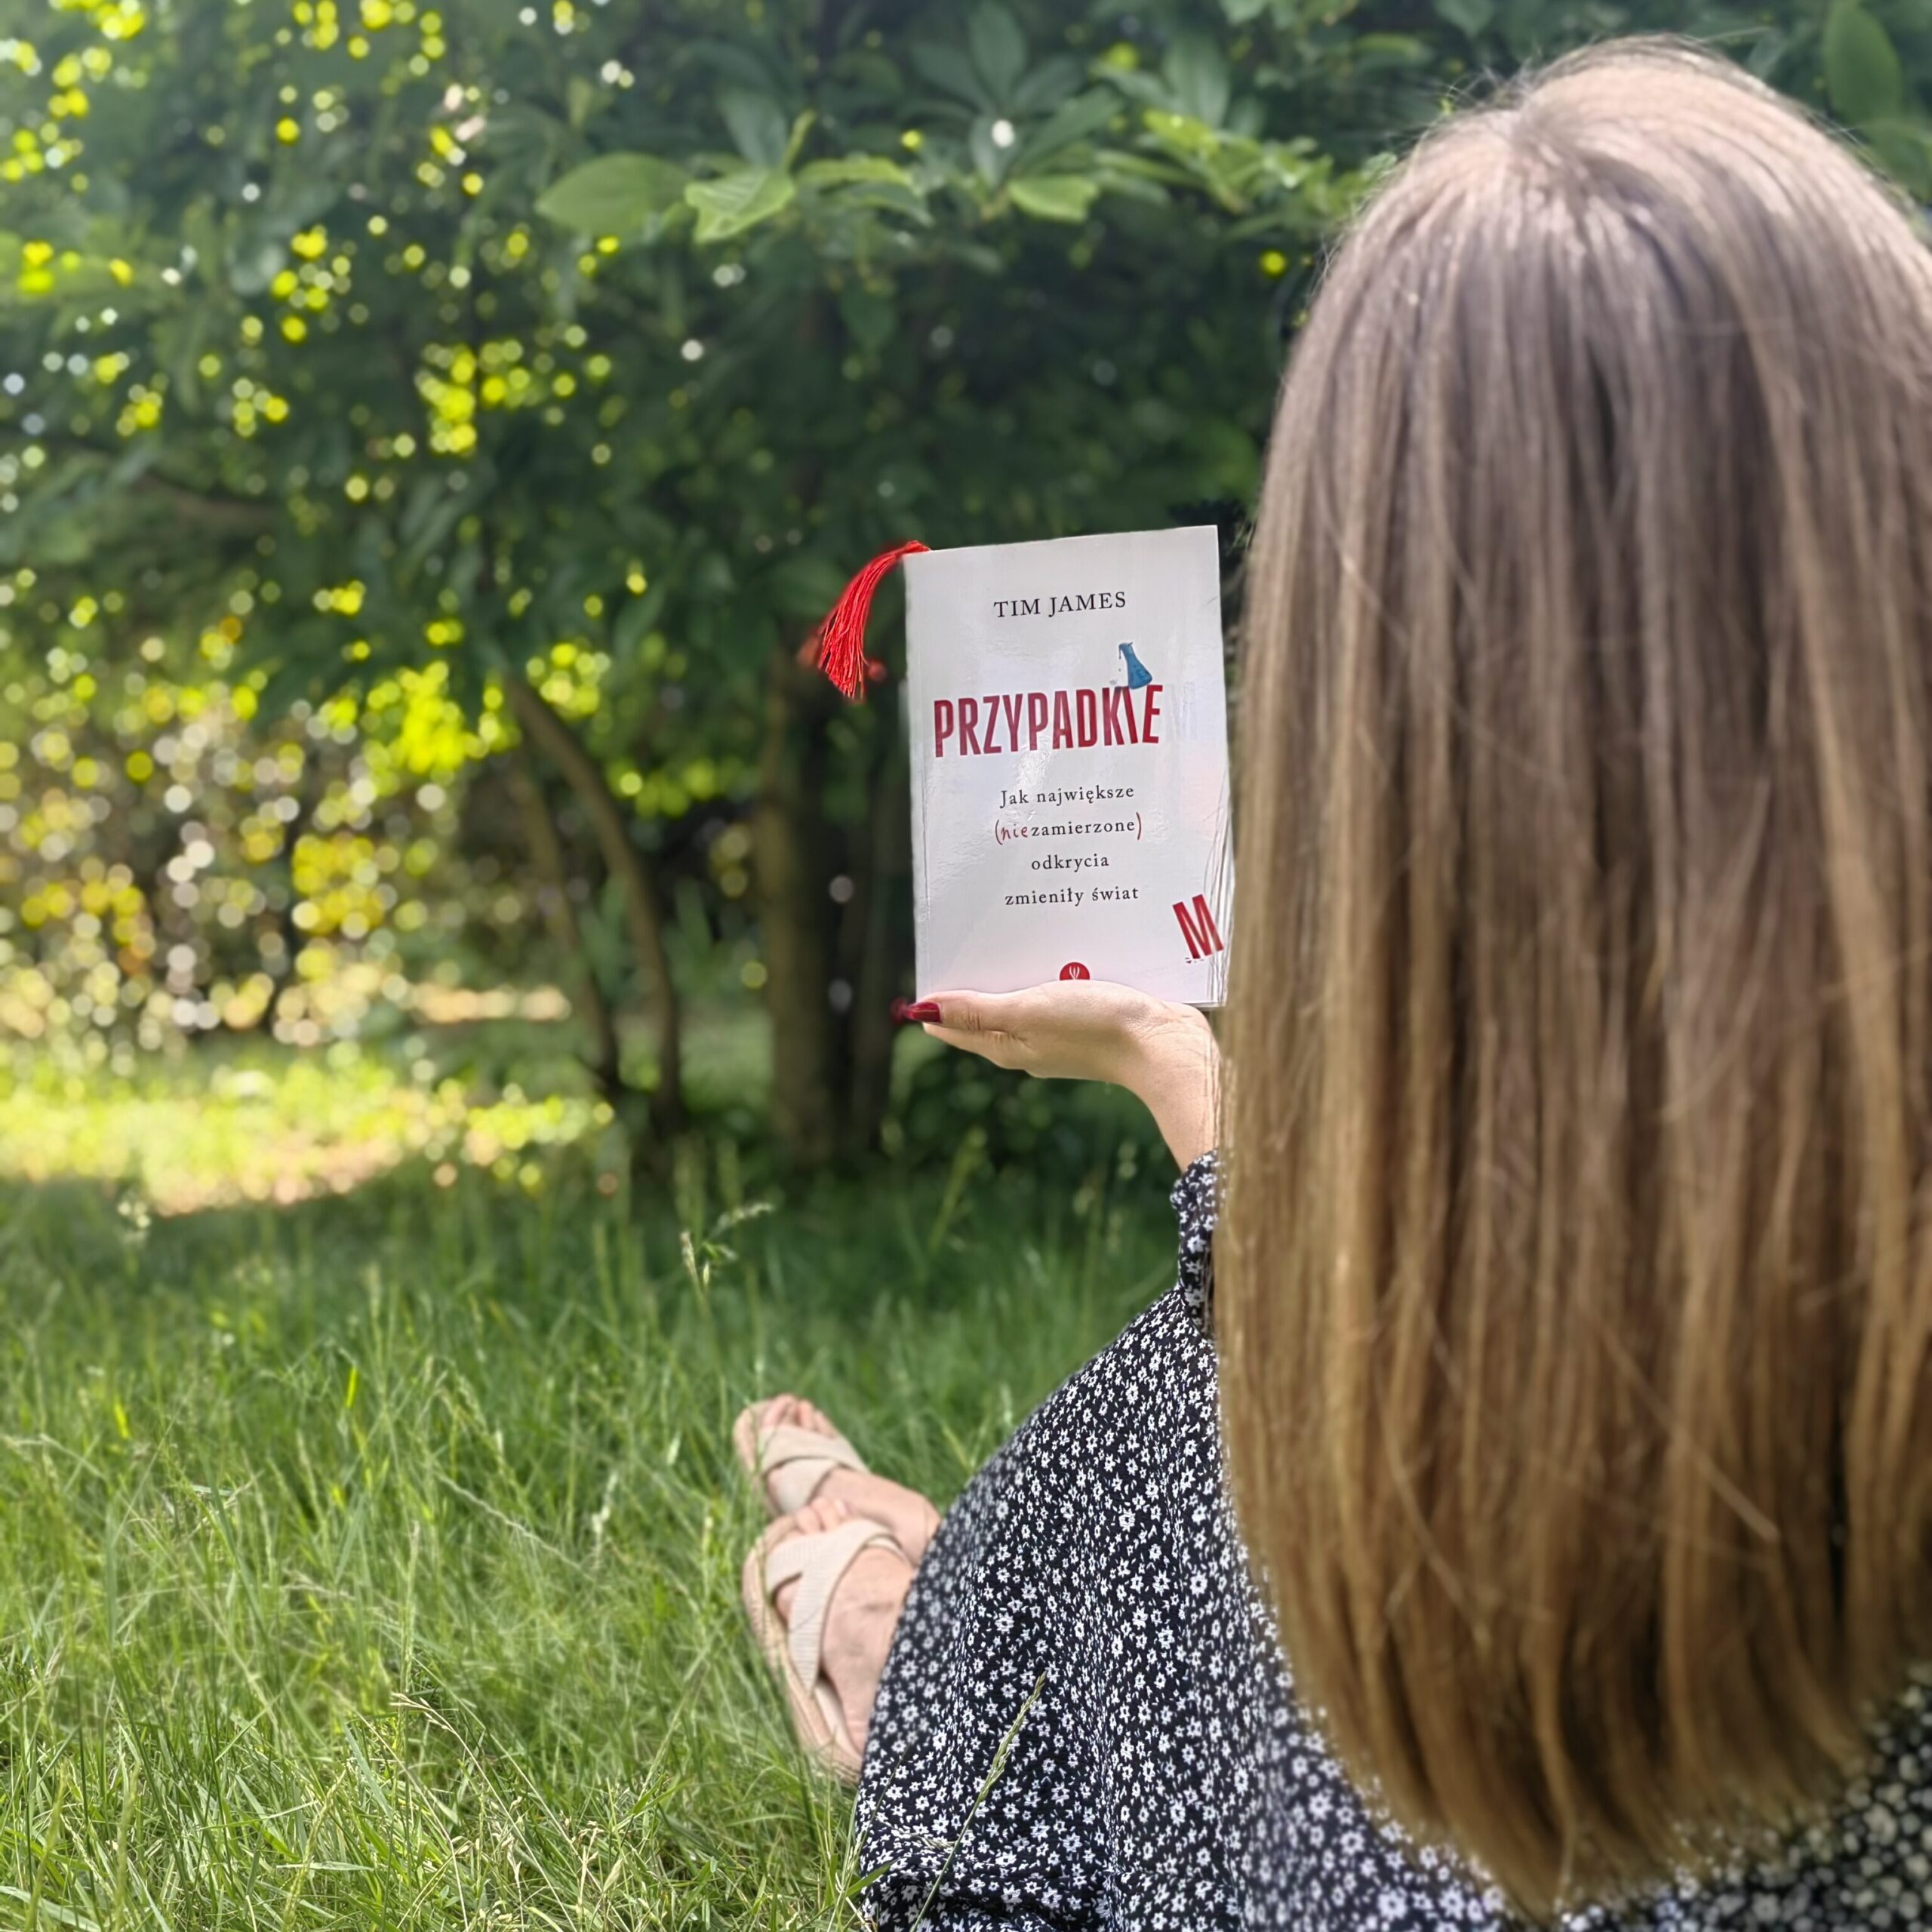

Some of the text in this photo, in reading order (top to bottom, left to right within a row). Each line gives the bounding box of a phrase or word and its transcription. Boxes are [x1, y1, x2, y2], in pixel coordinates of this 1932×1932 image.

[994, 592, 1126, 617] TIM JAMES
[934, 685, 1163, 758] PRZYPADKIE
[1000, 785, 1134, 808] Jak największe
[995, 812, 1142, 845] (niezamierzone)
[1031, 854, 1109, 872] odkrycia
[1004, 886, 1139, 906] zmieniły świat
[1172, 894, 1224, 959] M
